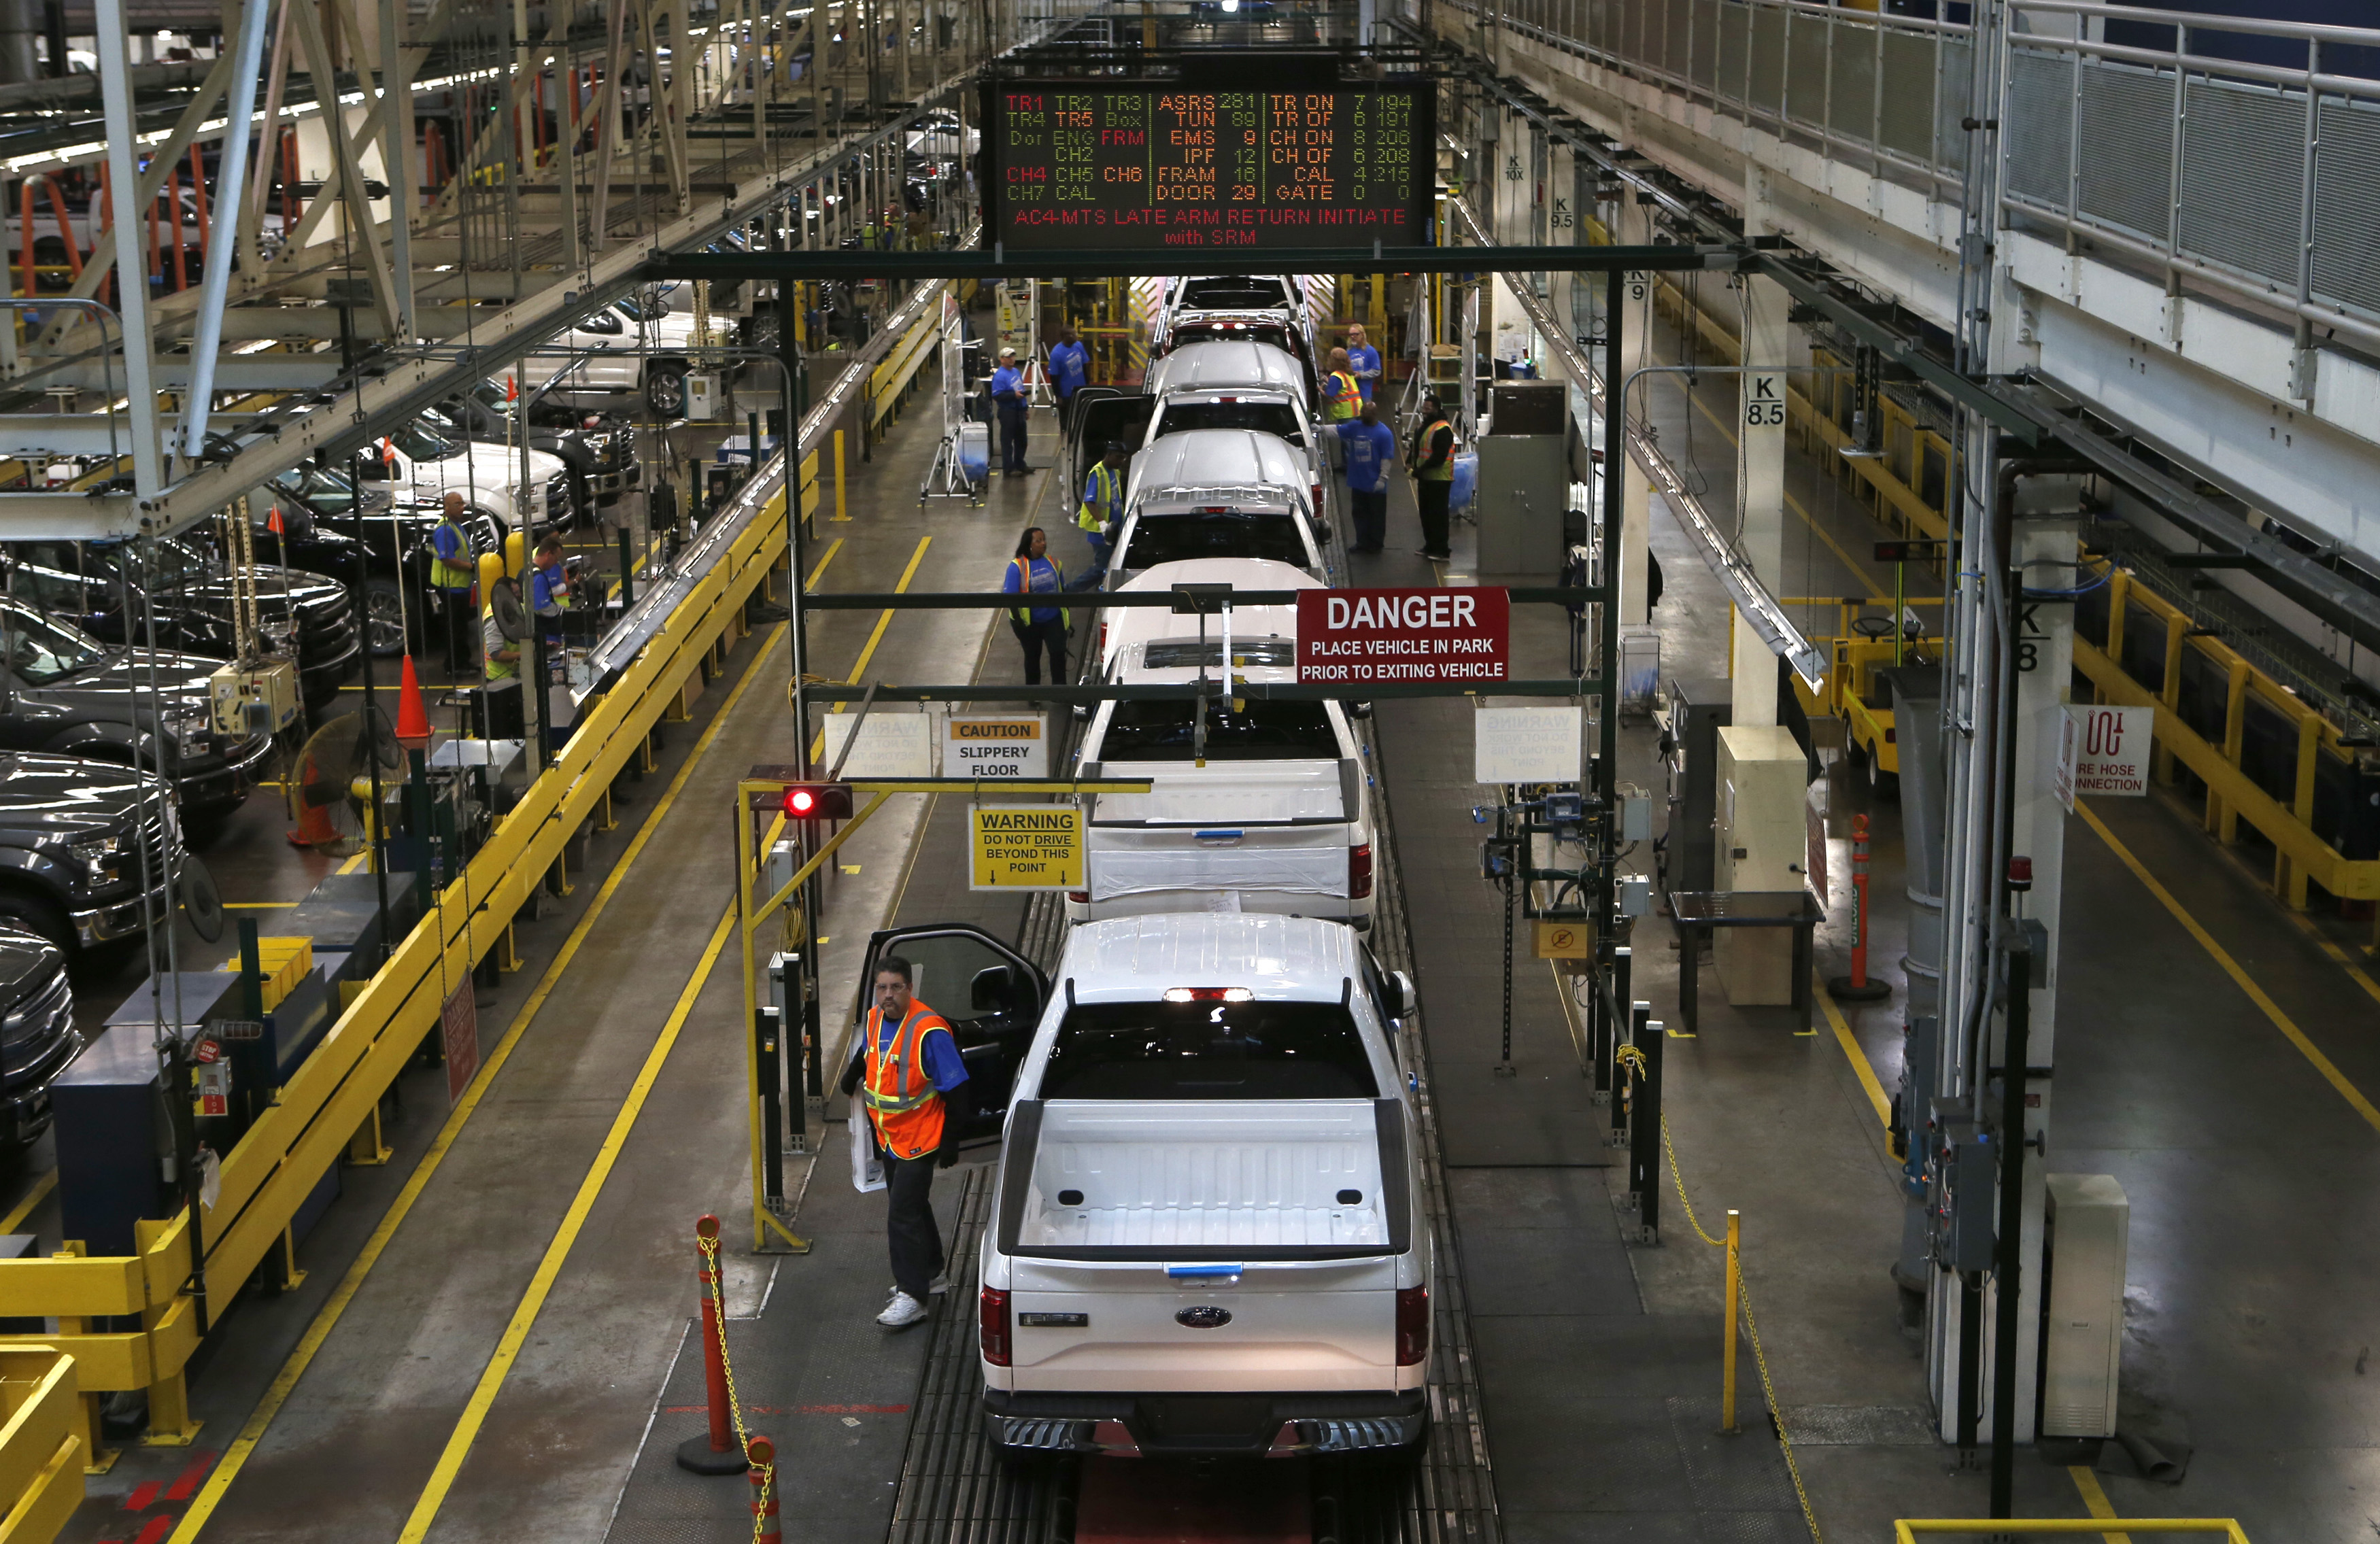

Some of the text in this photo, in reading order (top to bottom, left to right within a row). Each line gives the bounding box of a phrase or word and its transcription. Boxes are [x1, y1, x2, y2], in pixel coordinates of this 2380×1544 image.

[1006, 95, 1141, 110] TR1 TR2 TR3
[1159, 93, 1253, 110] ASRS 281
[1270, 95, 1412, 109] TR ON 7 194
[1006, 112, 1142, 126] TR4 TR5 Box
[1175, 112, 1255, 126] TUN 89
[1273, 111, 1409, 126] TR OF 6 191
[1010, 131, 1144, 145] Dor ENG FRM
[1171, 131, 1255, 145] EMS 9
[1270, 130, 1410, 145] CH ON 8 206
[1056, 147, 1093, 161] CH2
[1185, 148, 1255, 163] IPF 12
[1272, 148, 1410, 163] CH OF 6 208
[1510, 156, 1518, 167] K
[1007, 167, 1142, 182] CH4 CH5 CH6
[1159, 167, 1255, 182] FRAM 16
[1295, 167, 1410, 182] CAL 4 215
[1505, 170, 1523, 180] 10X
[1008, 186, 1095, 200] CH7 CAL
[1157, 186, 1255, 200] DOOR 29
[1276, 185, 1410, 200] GATE 0 0
[1556, 199, 1567, 211] K
[1115, 209, 1166, 224] LATE
[1174, 209, 1219, 224] ARM
[1228, 209, 1310, 224] RETURN
[1319, 209, 1405, 224] INITIATE
[1551, 215, 1573, 228] 9.5
[1166, 230, 1255, 244] with SRM
[1632, 285, 1644, 300] 9
[1757, 377, 1774, 398] K
[1748, 404, 1784, 425] 8.5
[1328, 596, 1476, 629] DANGER
[1312, 638, 1493, 655] PLACE VEHICLE IN PARK
[2019, 643, 2037, 672] 8
[1302, 663, 1503, 679] PRIOR TO EXITING VEHICLE
[960, 725, 1031, 737] CAUTION
[960, 747, 1030, 758] SLIPPERY
[972, 765, 1019, 776] FLOOR
[2076, 764, 2135, 776] IRE HOSE
[981, 814, 1074, 829] WARNING
[984, 835, 1071, 844] DO NOT DRIVE
[987, 849, 1069, 859] BEYOND THIS
[1010, 863, 1047, 873] POINT
[202, 1044, 217, 1054] STOP
